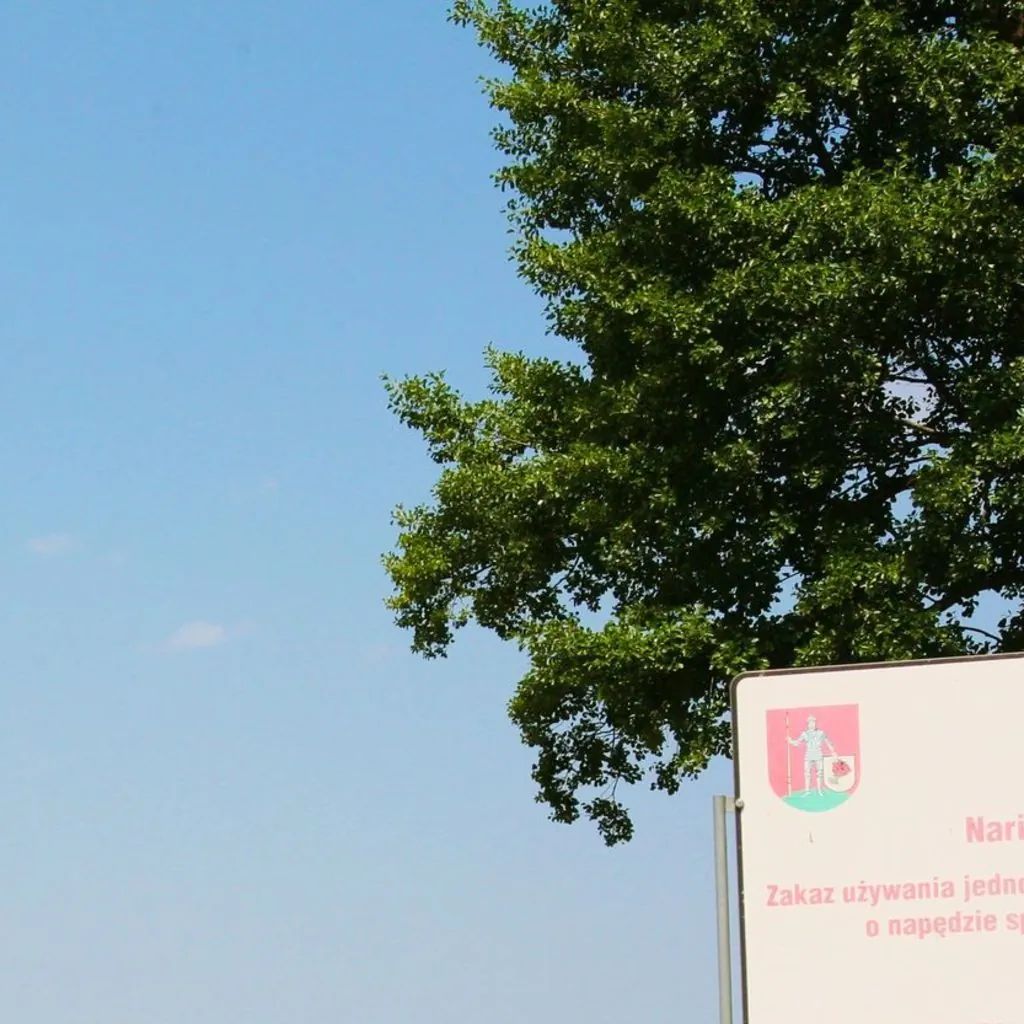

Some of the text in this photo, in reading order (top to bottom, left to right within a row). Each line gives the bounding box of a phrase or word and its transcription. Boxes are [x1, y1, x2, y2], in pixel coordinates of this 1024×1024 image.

[766, 883, 835, 907] Zakaz
[842, 877, 955, 907] używania
[865, 919, 879, 937] o
[888, 910, 997, 940] napędzie
